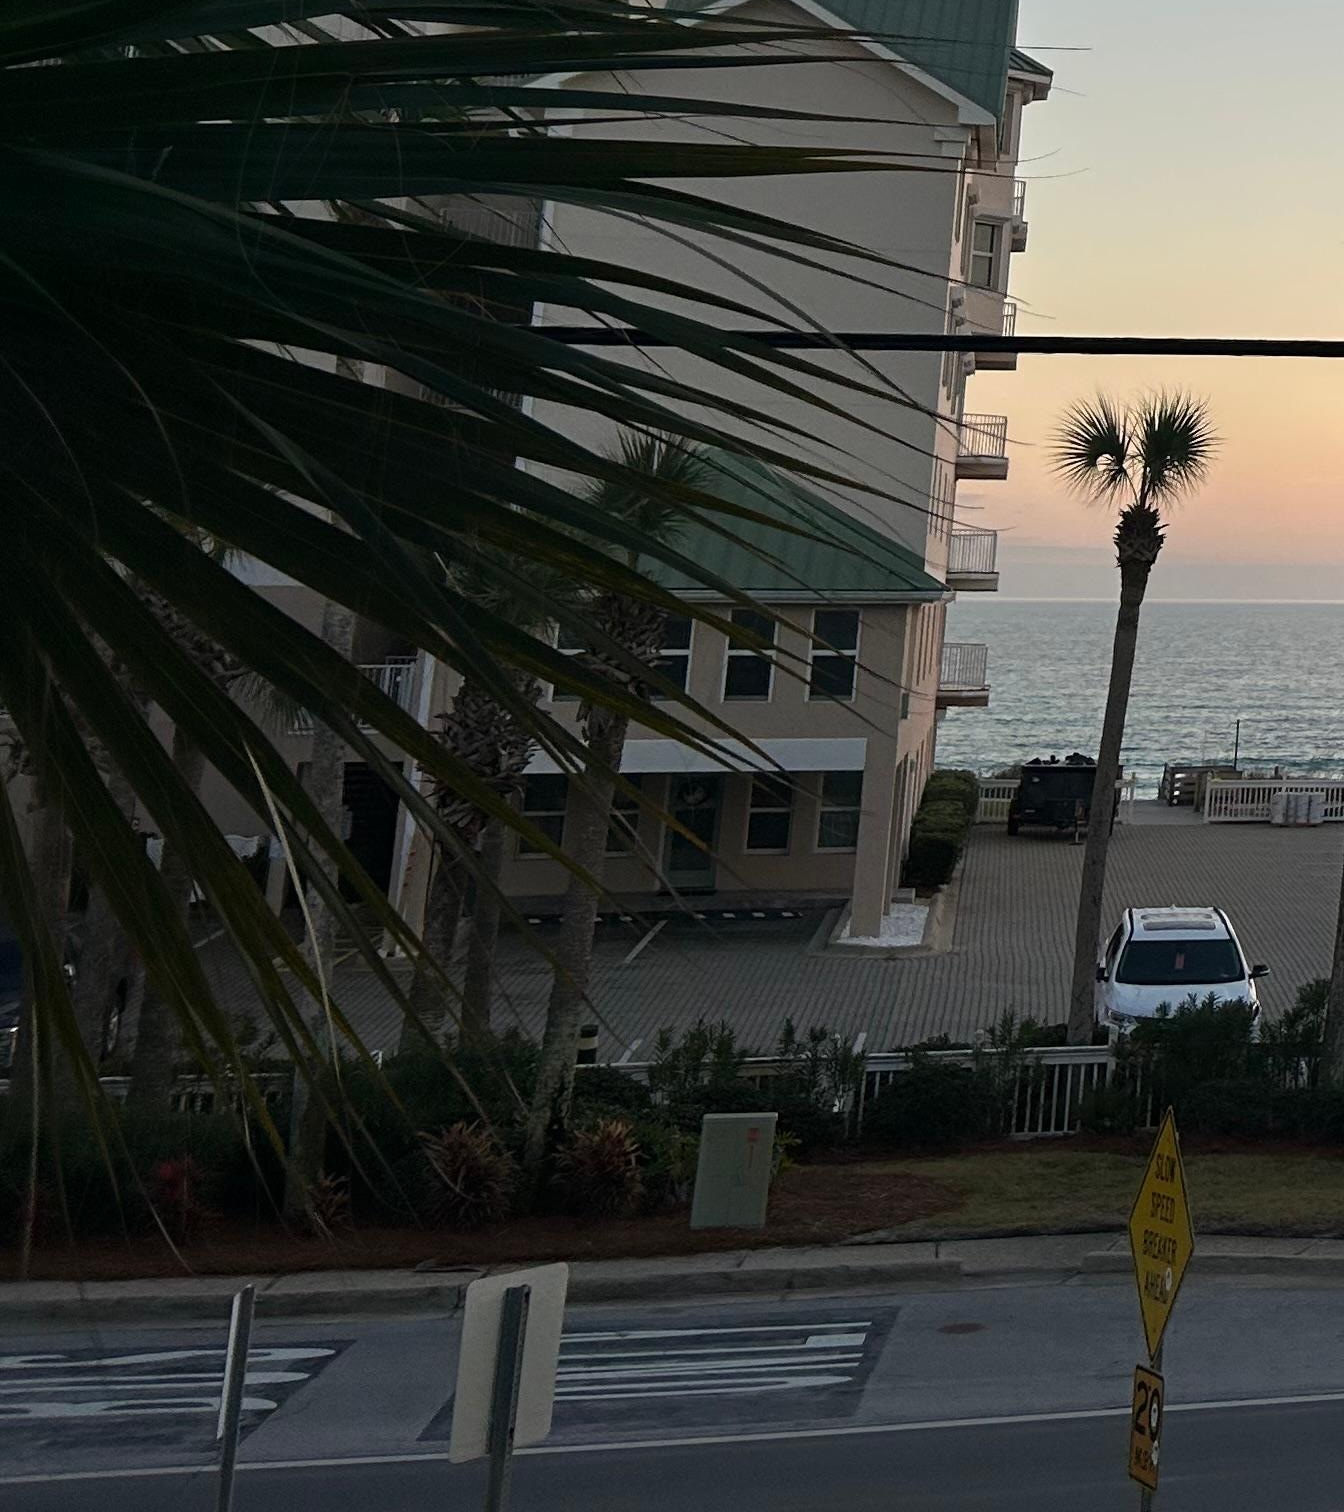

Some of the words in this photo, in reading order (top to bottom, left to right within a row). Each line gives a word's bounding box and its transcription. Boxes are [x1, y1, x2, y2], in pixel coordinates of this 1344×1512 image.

[1155, 1153, 1176, 1184] SLOW
[1150, 1191, 1175, 1224] SPEED
[1135, 1380, 1160, 1443] 20
